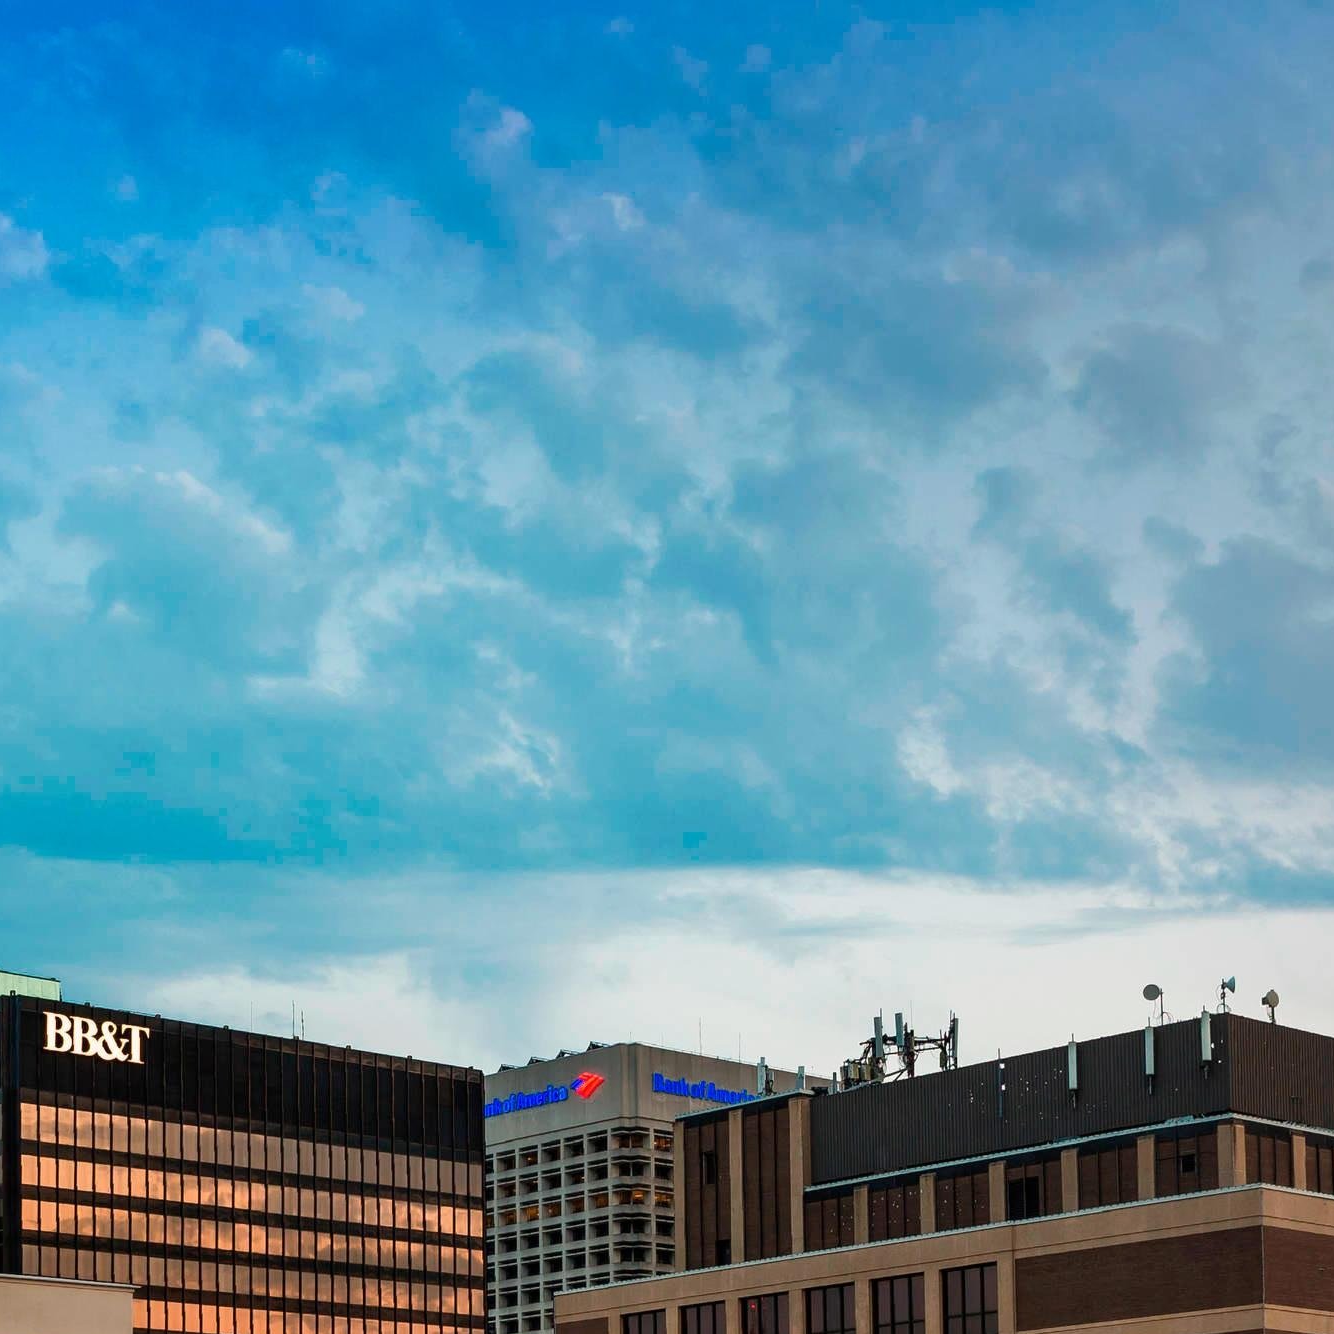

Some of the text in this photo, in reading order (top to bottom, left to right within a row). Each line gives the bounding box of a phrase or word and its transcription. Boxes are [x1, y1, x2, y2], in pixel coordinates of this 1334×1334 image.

[43, 1011, 150, 1064] BB&T
[503, 1094, 517, 1113] of
[516, 1085, 568, 1110] America
[651, 1072, 689, 1097] Bank
[690, 1080, 706, 1100] of
